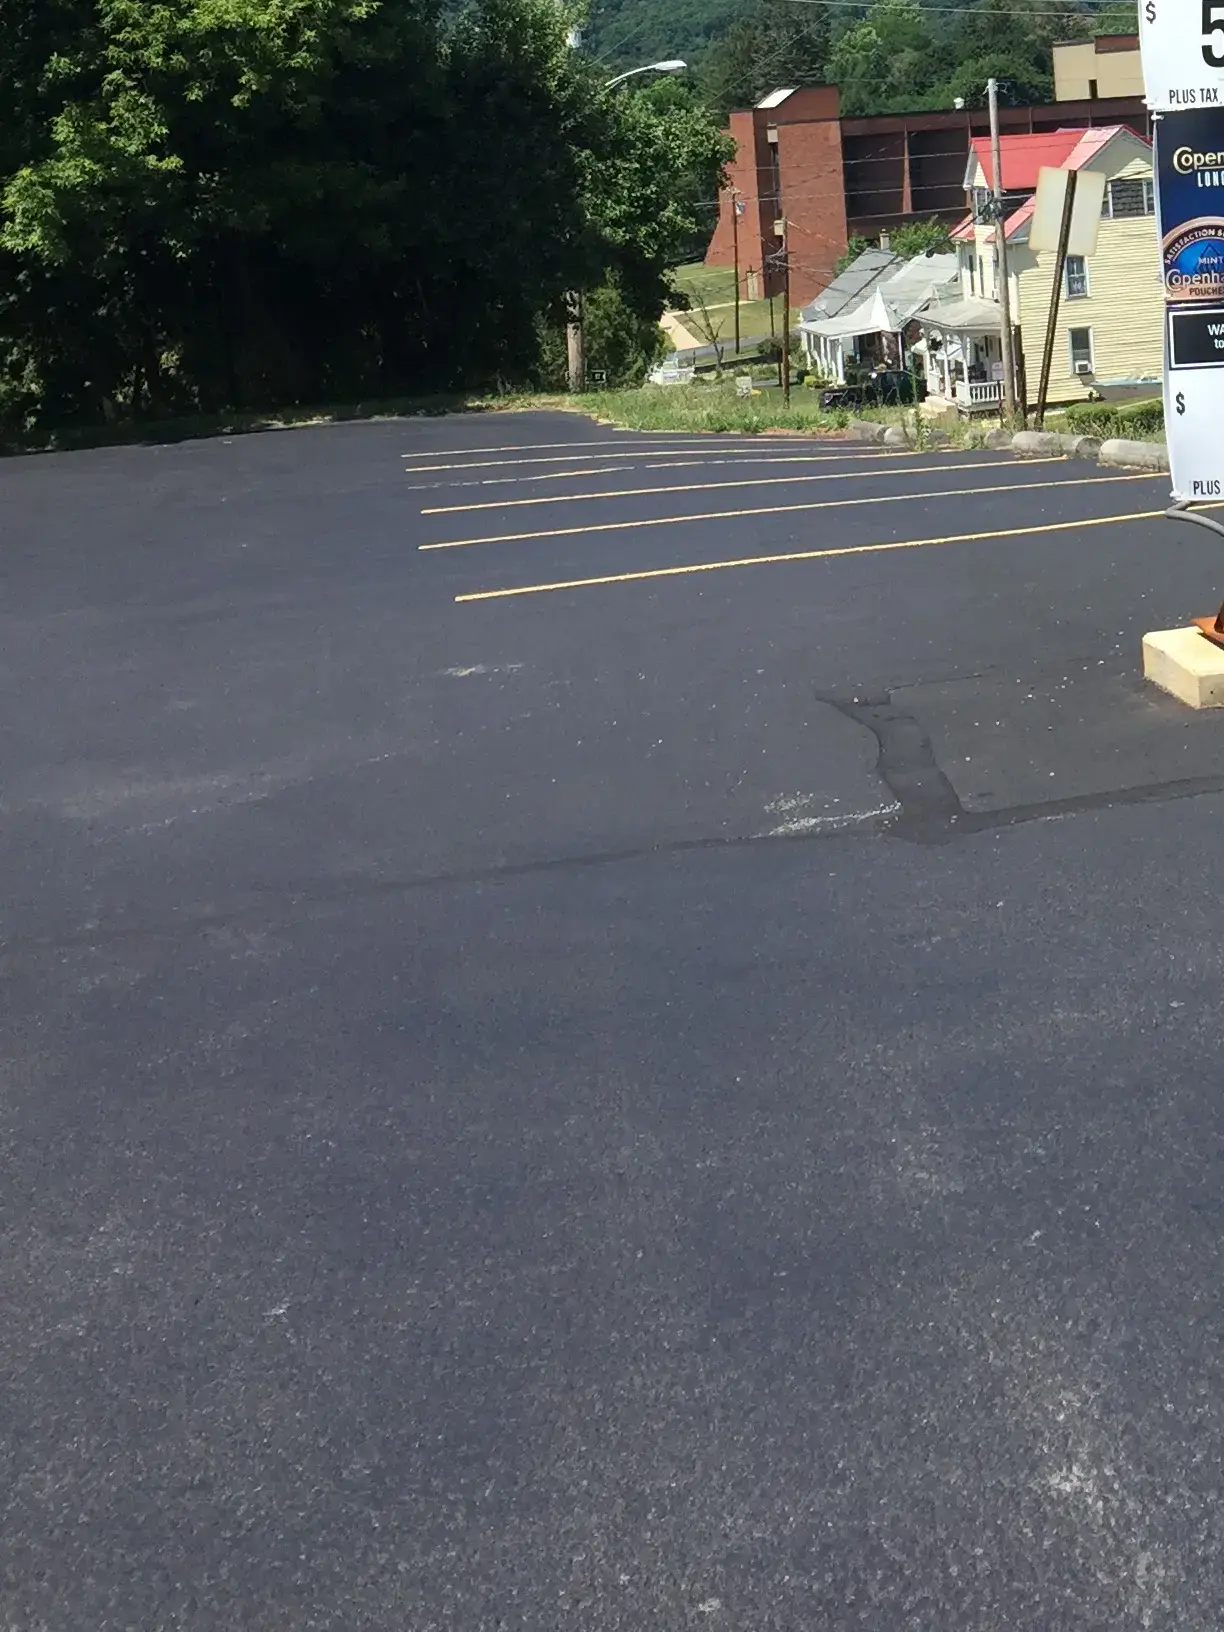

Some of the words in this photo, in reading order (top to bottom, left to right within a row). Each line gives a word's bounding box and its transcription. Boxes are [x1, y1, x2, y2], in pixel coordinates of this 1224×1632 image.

[1169, 89, 1196, 105] PLUS
[1200, 88, 1219, 104] TAX
[1164, 229, 1216, 265] SATISFACTION
[1198, 255, 1224, 265] MINT
[1193, 480, 1221, 495] PLUS
